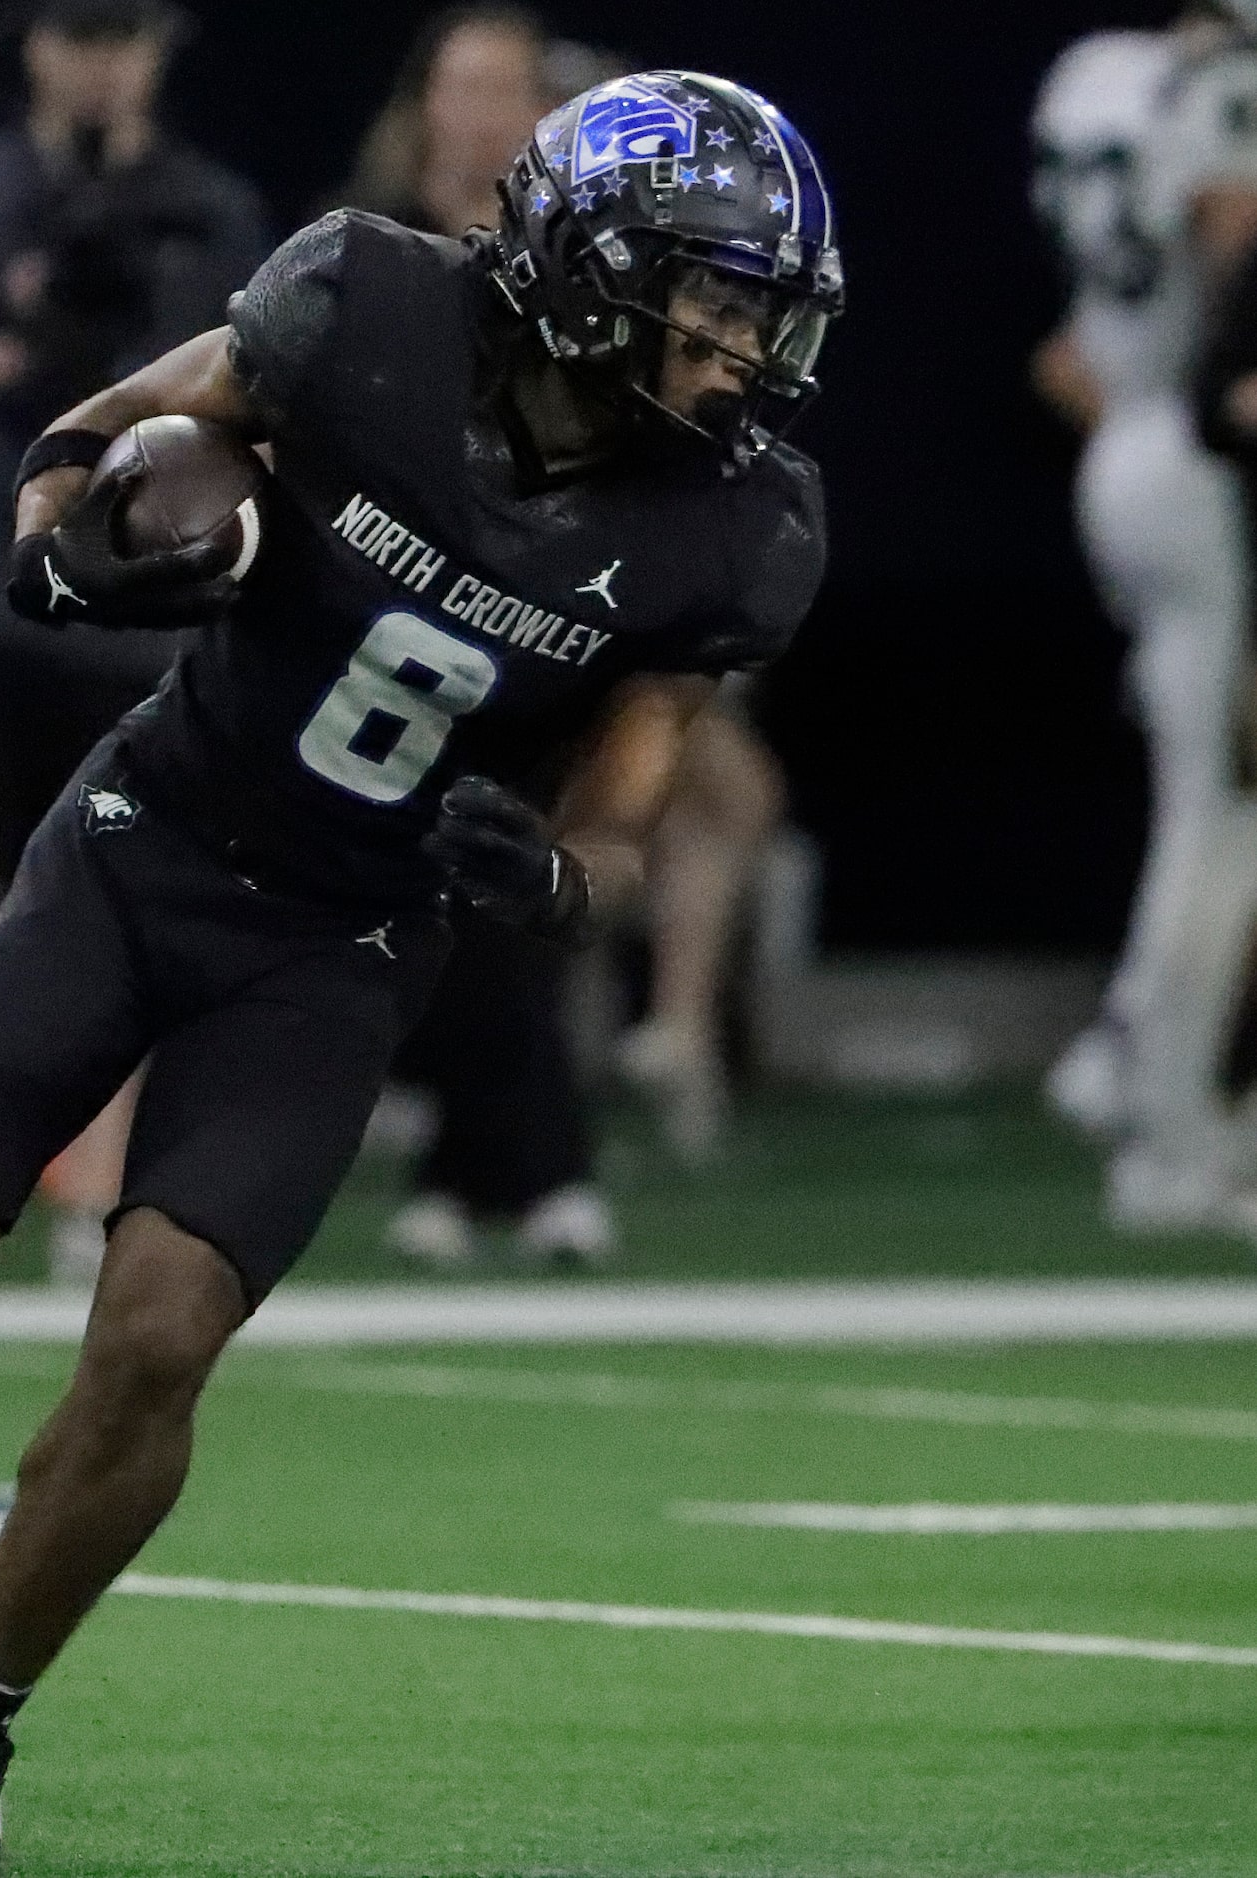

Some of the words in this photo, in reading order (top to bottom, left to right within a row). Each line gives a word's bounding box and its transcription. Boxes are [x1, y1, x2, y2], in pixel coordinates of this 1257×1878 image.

[331, 493, 447, 593] NORTH
[441, 574, 613, 667] CROWLEY
[297, 610, 498, 803] 8
